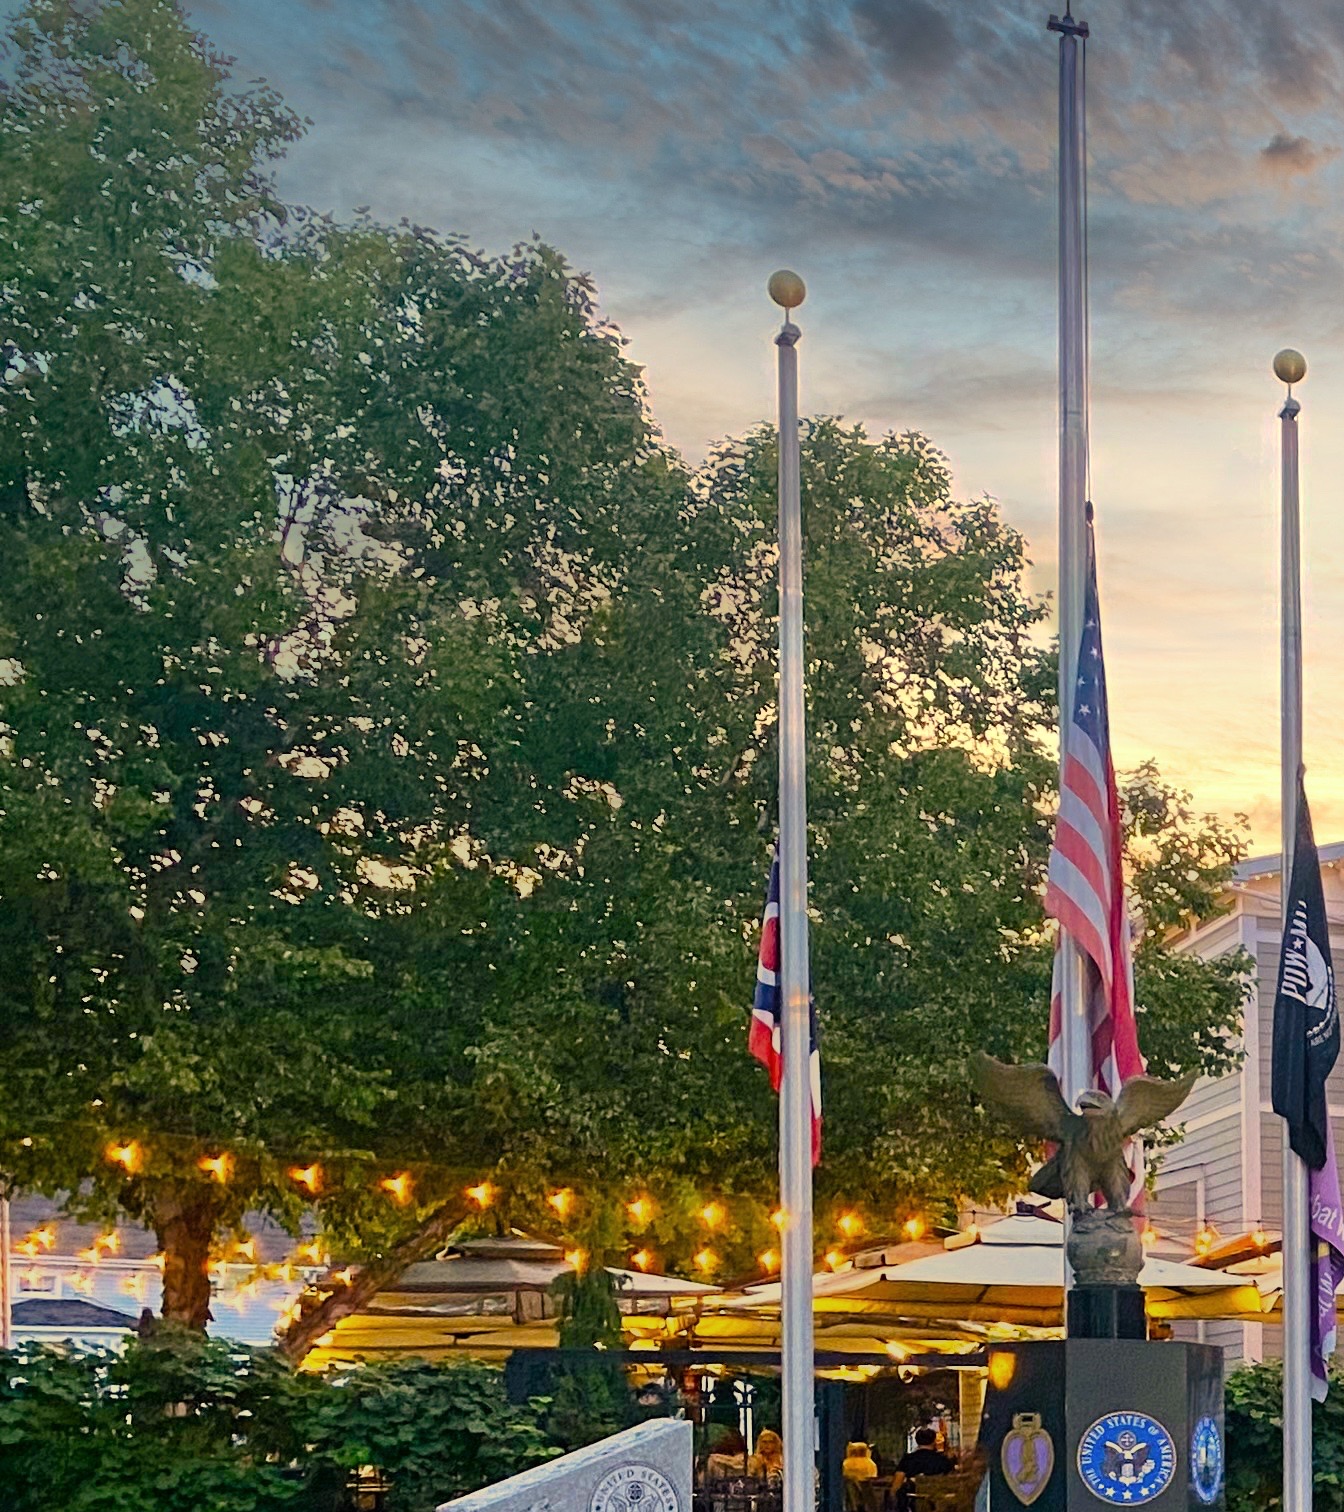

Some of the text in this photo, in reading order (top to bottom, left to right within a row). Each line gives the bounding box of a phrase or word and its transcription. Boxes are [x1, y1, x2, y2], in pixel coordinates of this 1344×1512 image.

[1281, 948, 1308, 1006] POW
[1081, 1415, 1173, 1487] THE UNITED STATES OF AMERICA
[641, 1470, 674, 1504] STATES
